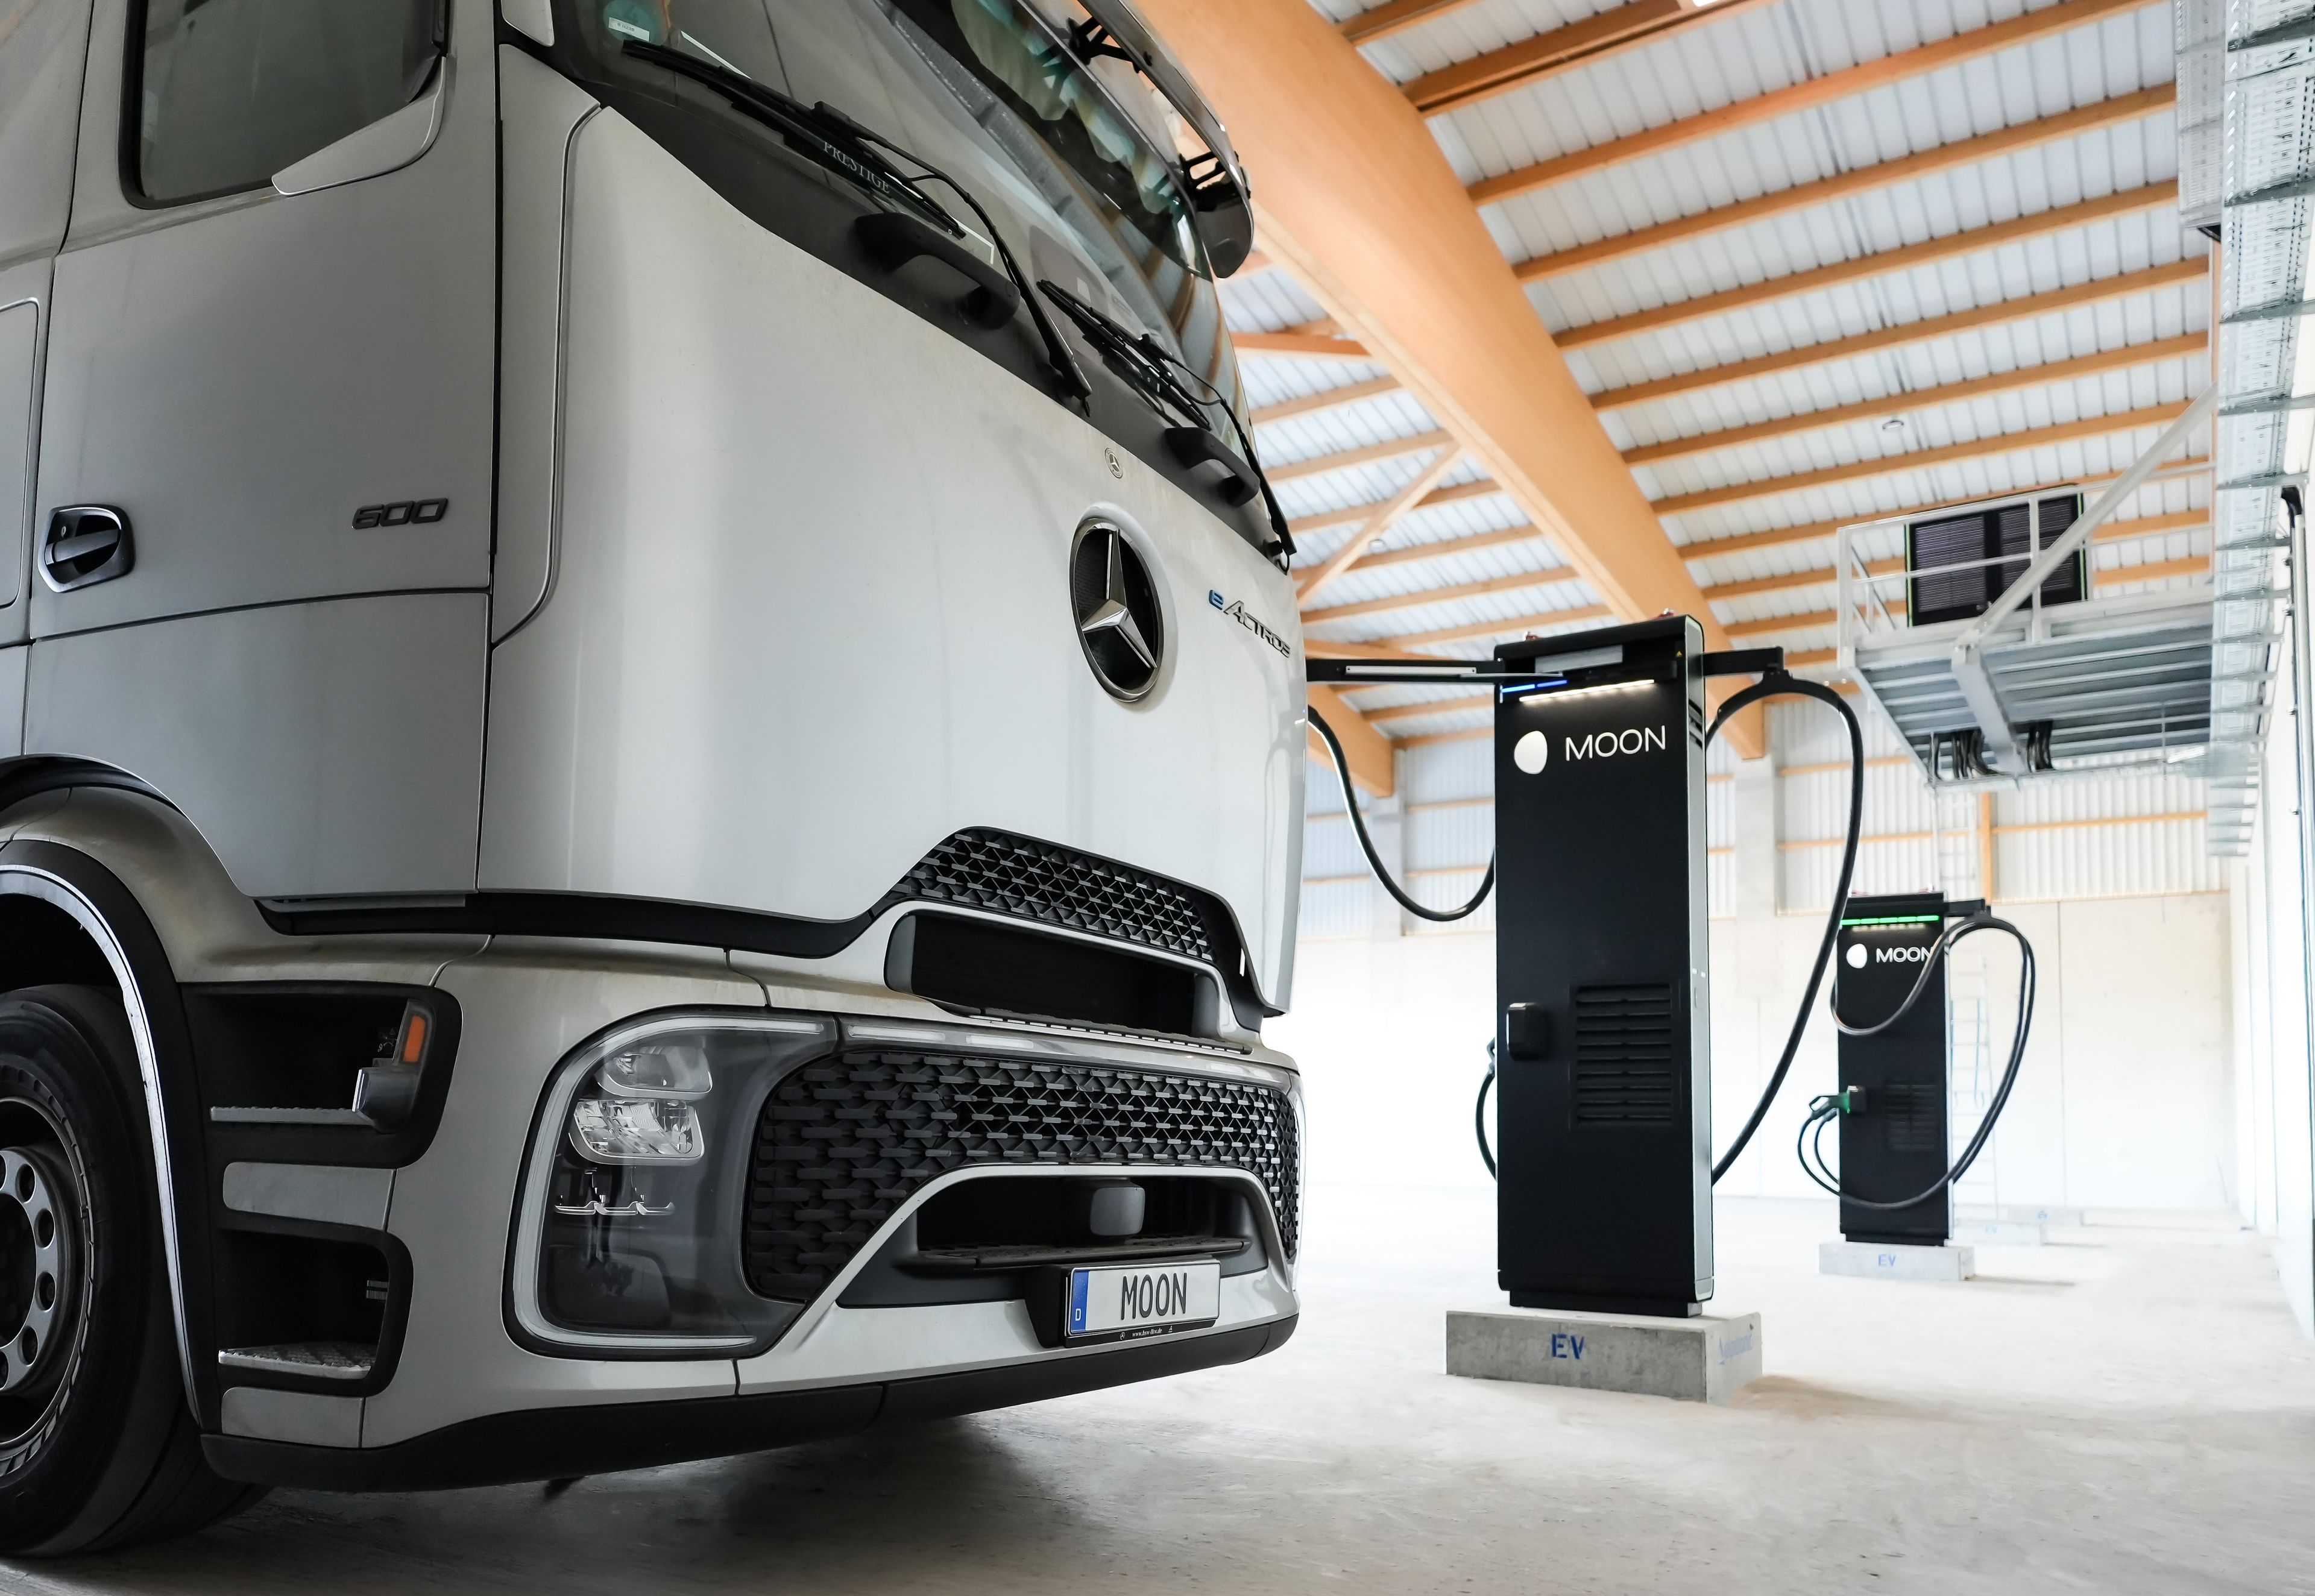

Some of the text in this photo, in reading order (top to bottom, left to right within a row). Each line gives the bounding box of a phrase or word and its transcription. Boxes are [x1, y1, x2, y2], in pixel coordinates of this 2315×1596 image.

[823, 142, 890, 193] PRESTIGE
[351, 498, 449, 530] 600
[1565, 725, 1666, 762] MOON
[1878, 1254, 1897, 1267] EV
[1075, 1272, 1188, 1321] D MOON
[1551, 1333, 1585, 1360] EV
